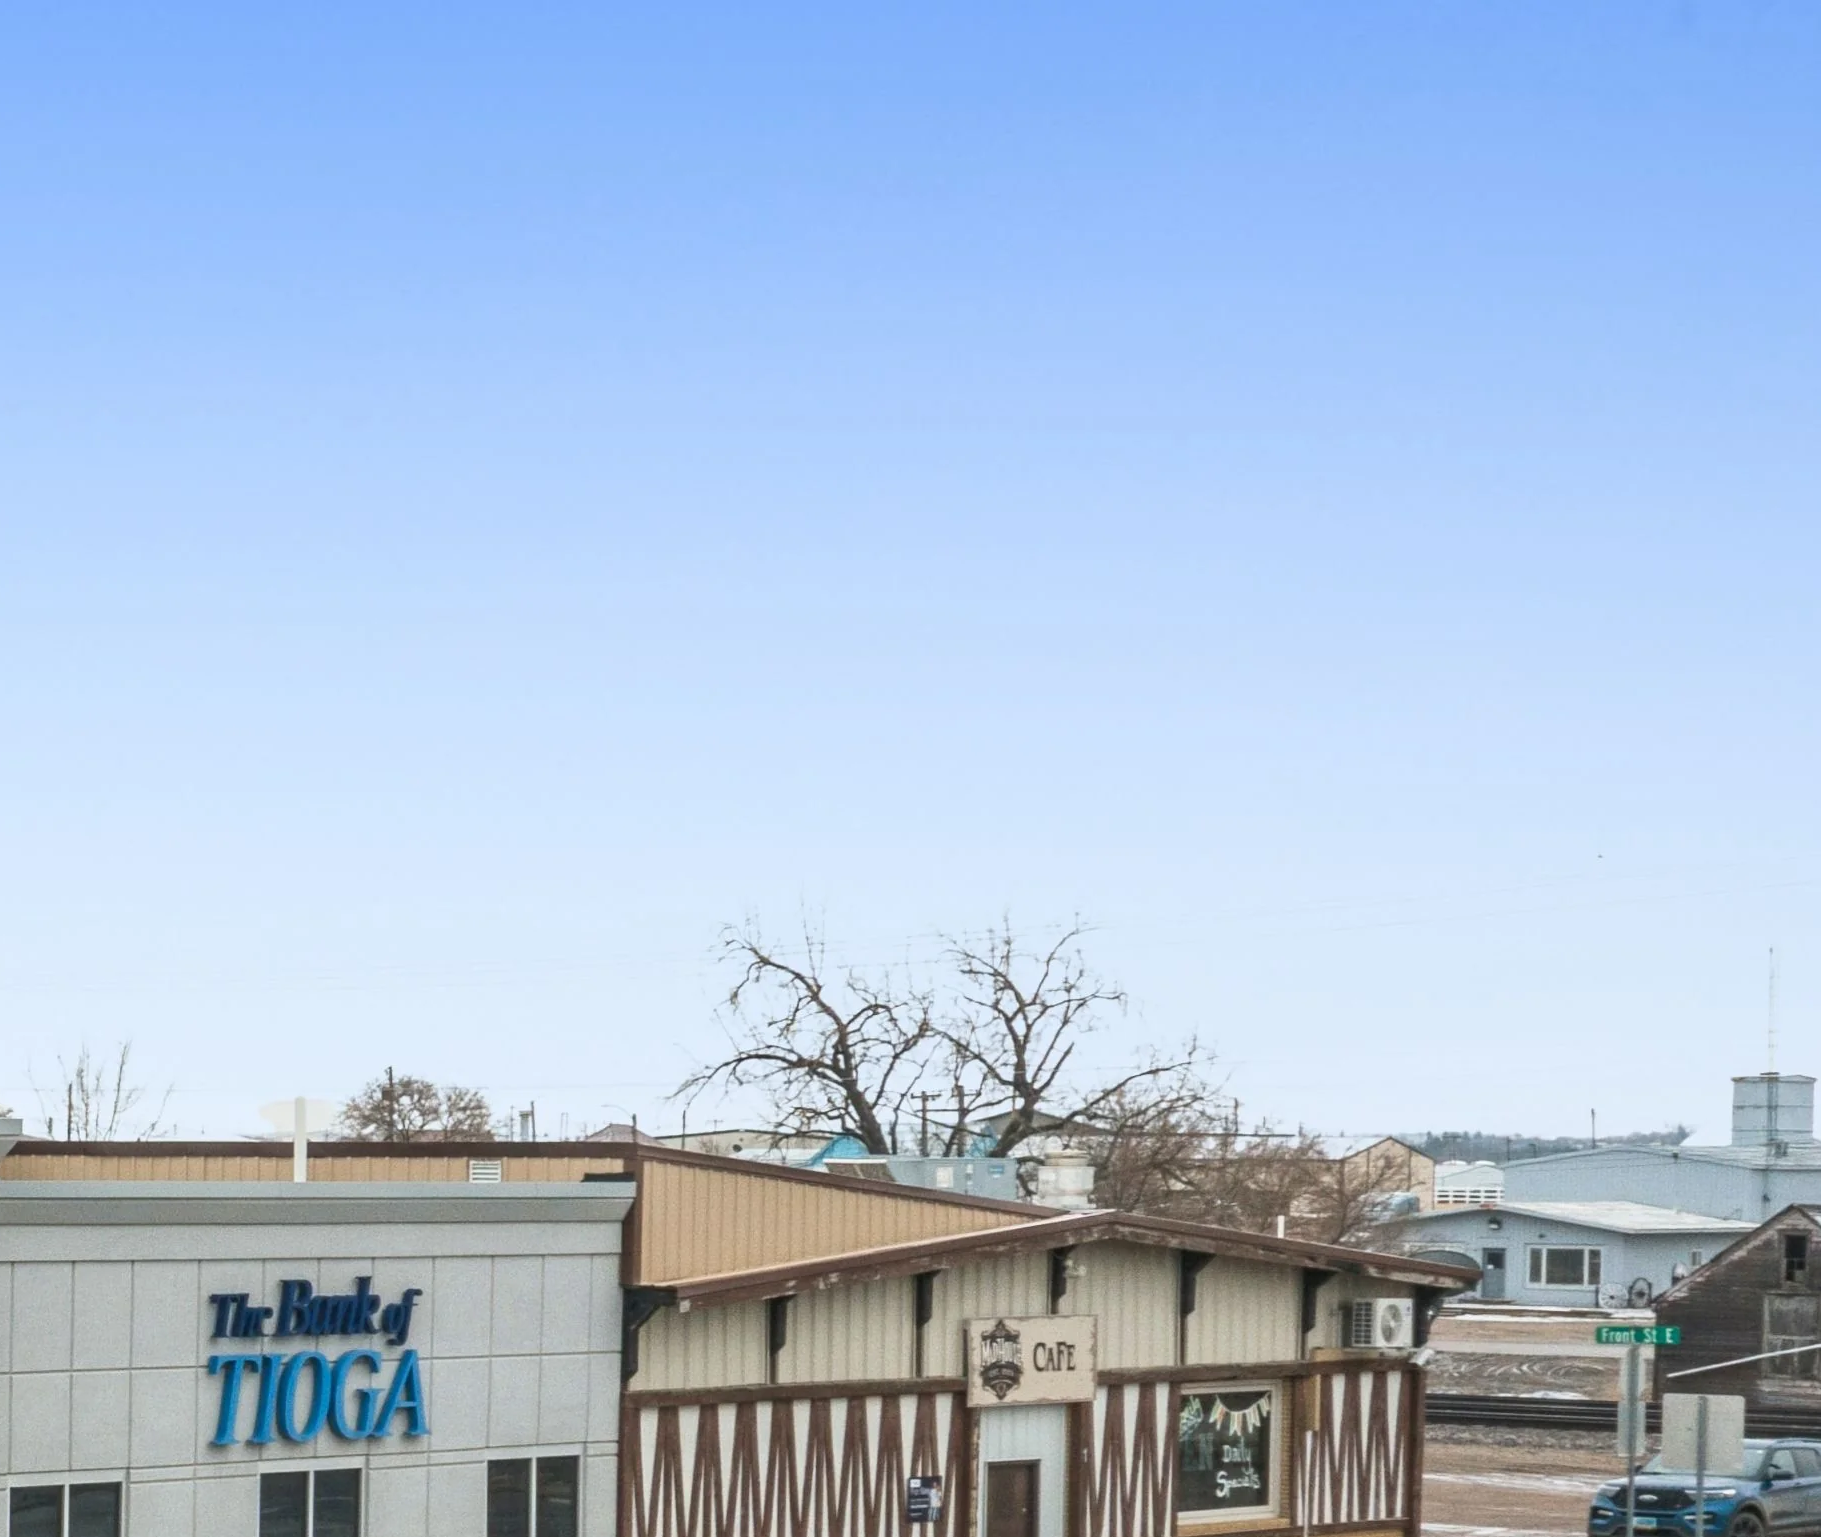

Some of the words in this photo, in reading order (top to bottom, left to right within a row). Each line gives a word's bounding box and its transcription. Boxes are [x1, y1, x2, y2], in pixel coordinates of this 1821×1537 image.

[272, 1276, 381, 1337] Bank
[381, 1288, 423, 1346] of
[1601, 1327, 1637, 1343] Front
[1642, 1328, 1657, 1343] St
[1665, 1327, 1674, 1343] E
[207, 1347, 431, 1446] TIOGA
[1222, 1436, 1255, 1475] Daily
[1215, 1470, 1261, 1498] Specials
